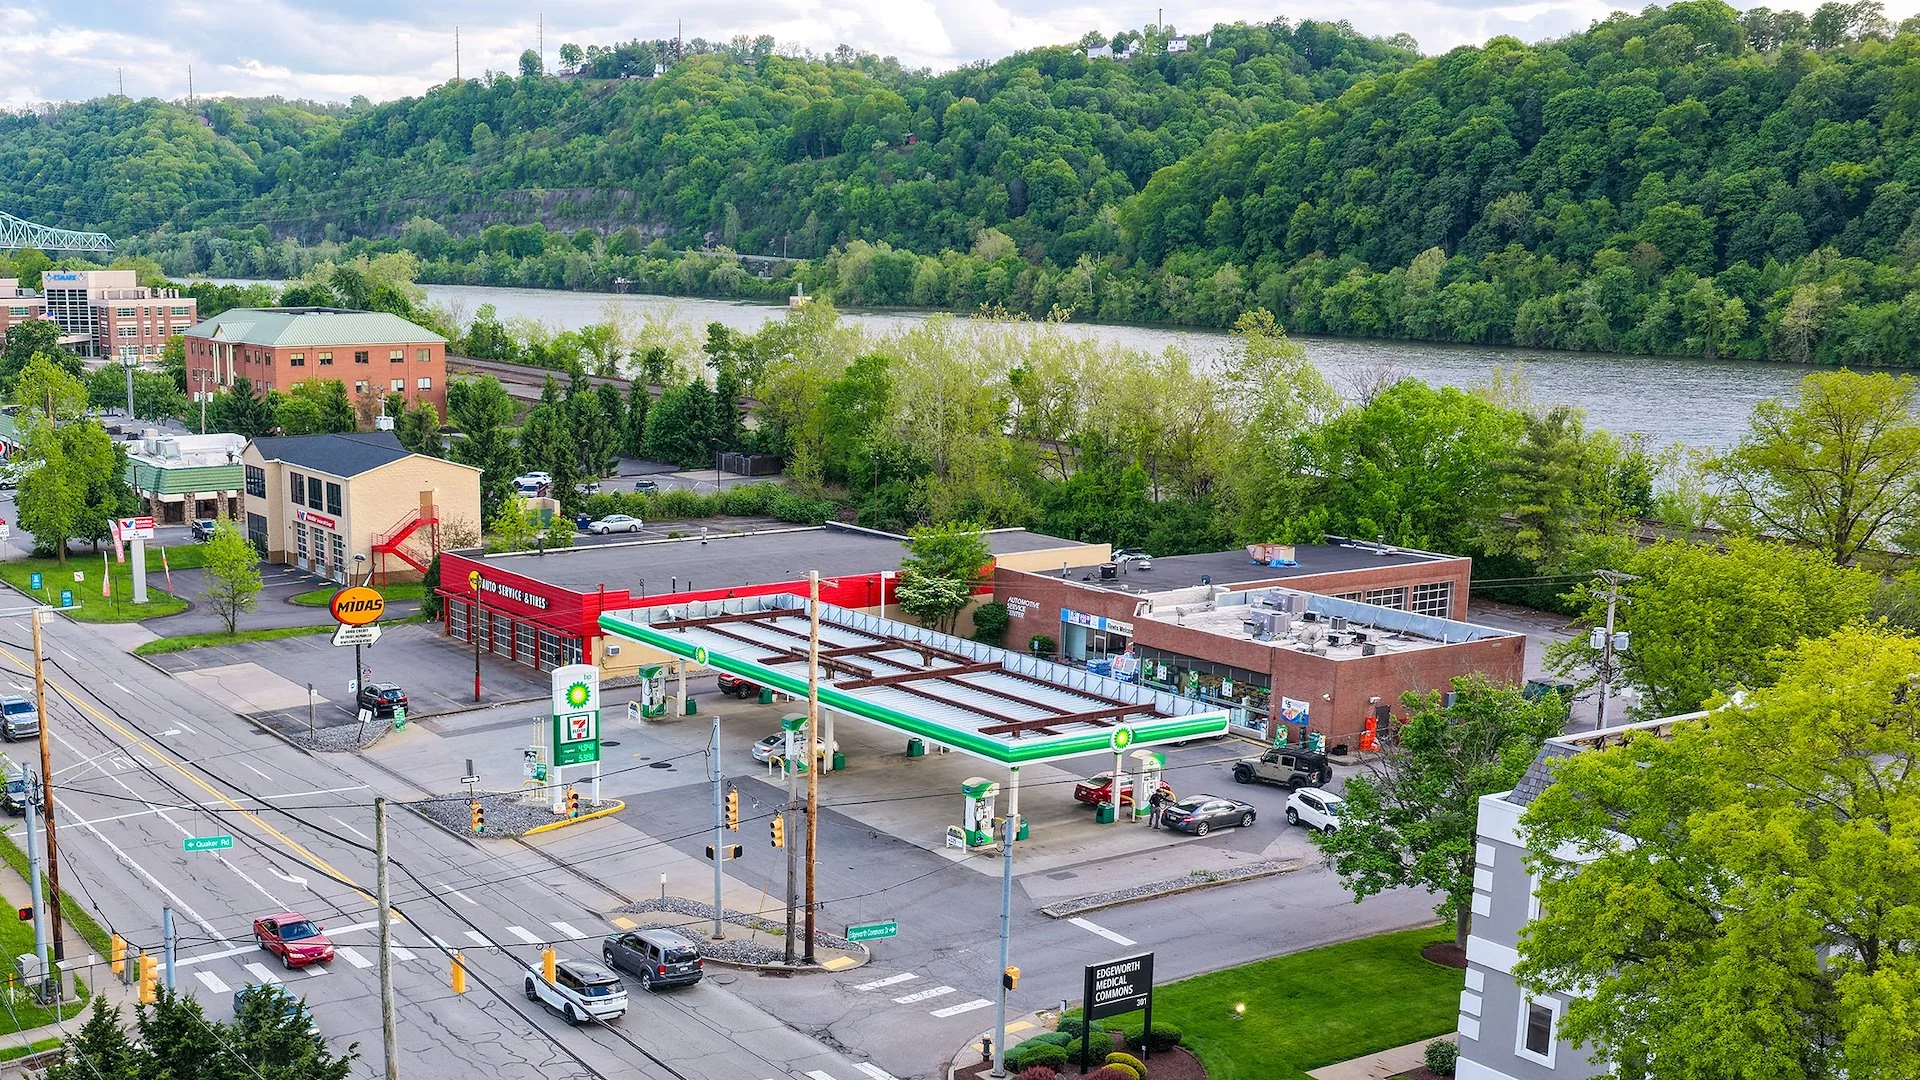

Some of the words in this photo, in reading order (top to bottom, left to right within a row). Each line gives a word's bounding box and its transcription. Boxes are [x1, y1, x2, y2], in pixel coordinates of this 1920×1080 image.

[482, 579, 497, 593] AUTO
[498, 584, 522, 601] SERVICE
[337, 597, 383, 615] MIDAS
[1007, 603, 1026, 613] SERVICE
[1008, 597, 1040, 609] AUTOMOTIVE
[1007, 609, 1025, 619] CENTER
[583, 673, 592, 681] bp
[196, 840, 218, 849] Quaker
[220, 839, 230, 847] Rd
[1096, 960, 1141, 979] EDGEWORTH
[1095, 975, 1128, 991] MEDICAL
[1095, 984, 1134, 1002] COMMONS
[1136, 997, 1147, 1007] 301
